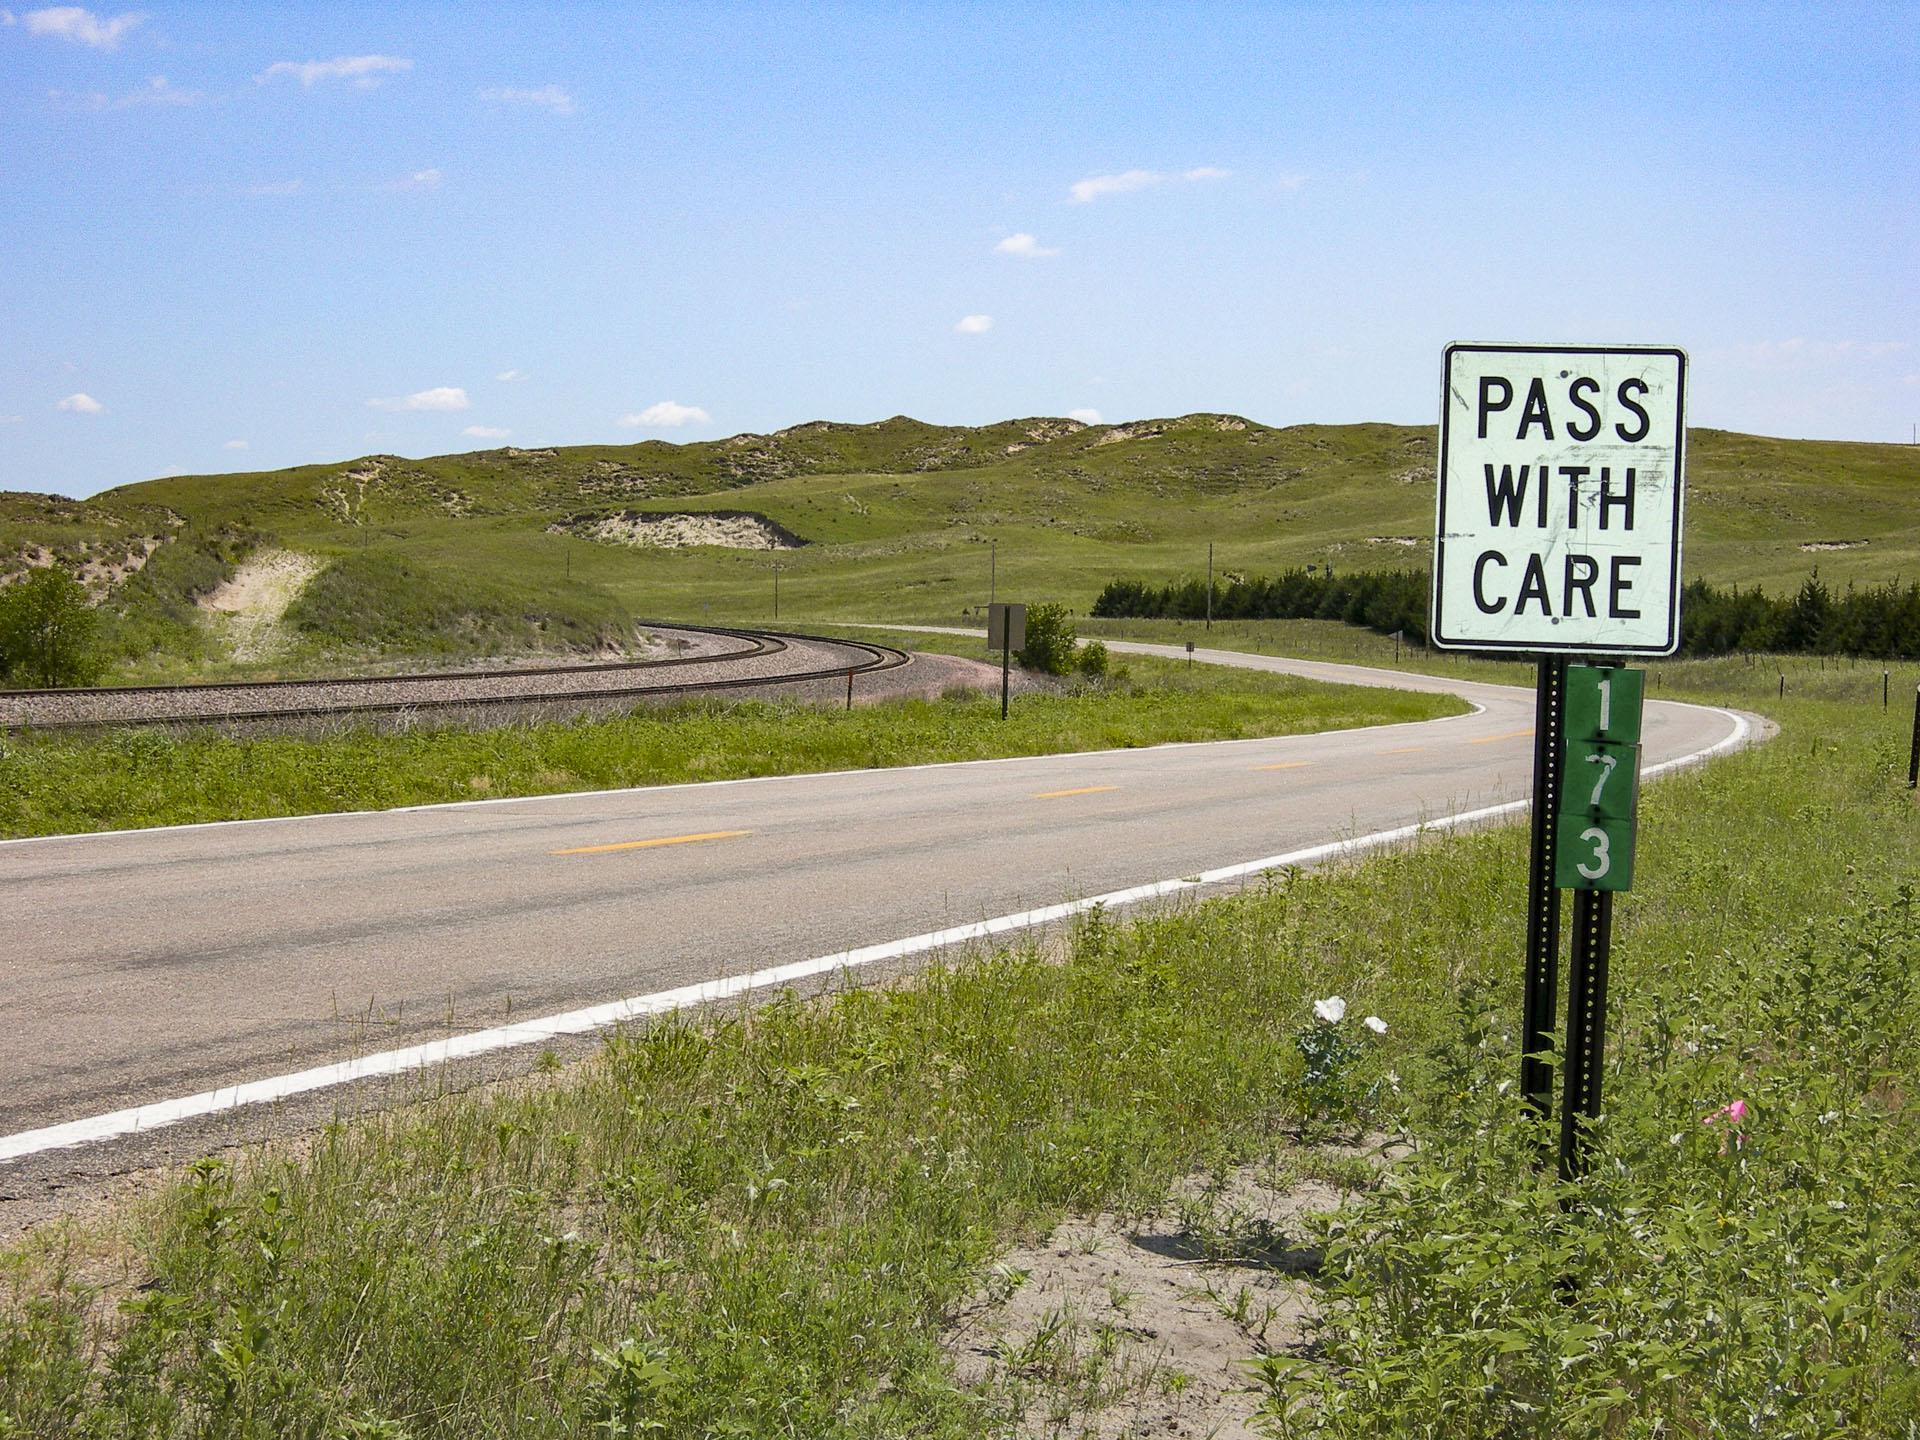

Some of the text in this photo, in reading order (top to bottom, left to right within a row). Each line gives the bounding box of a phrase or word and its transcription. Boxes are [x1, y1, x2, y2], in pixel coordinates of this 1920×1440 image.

[1477, 376, 1650, 442] PASS
[1484, 463, 1636, 530] WITH
[1473, 550, 1642, 619] CARE
